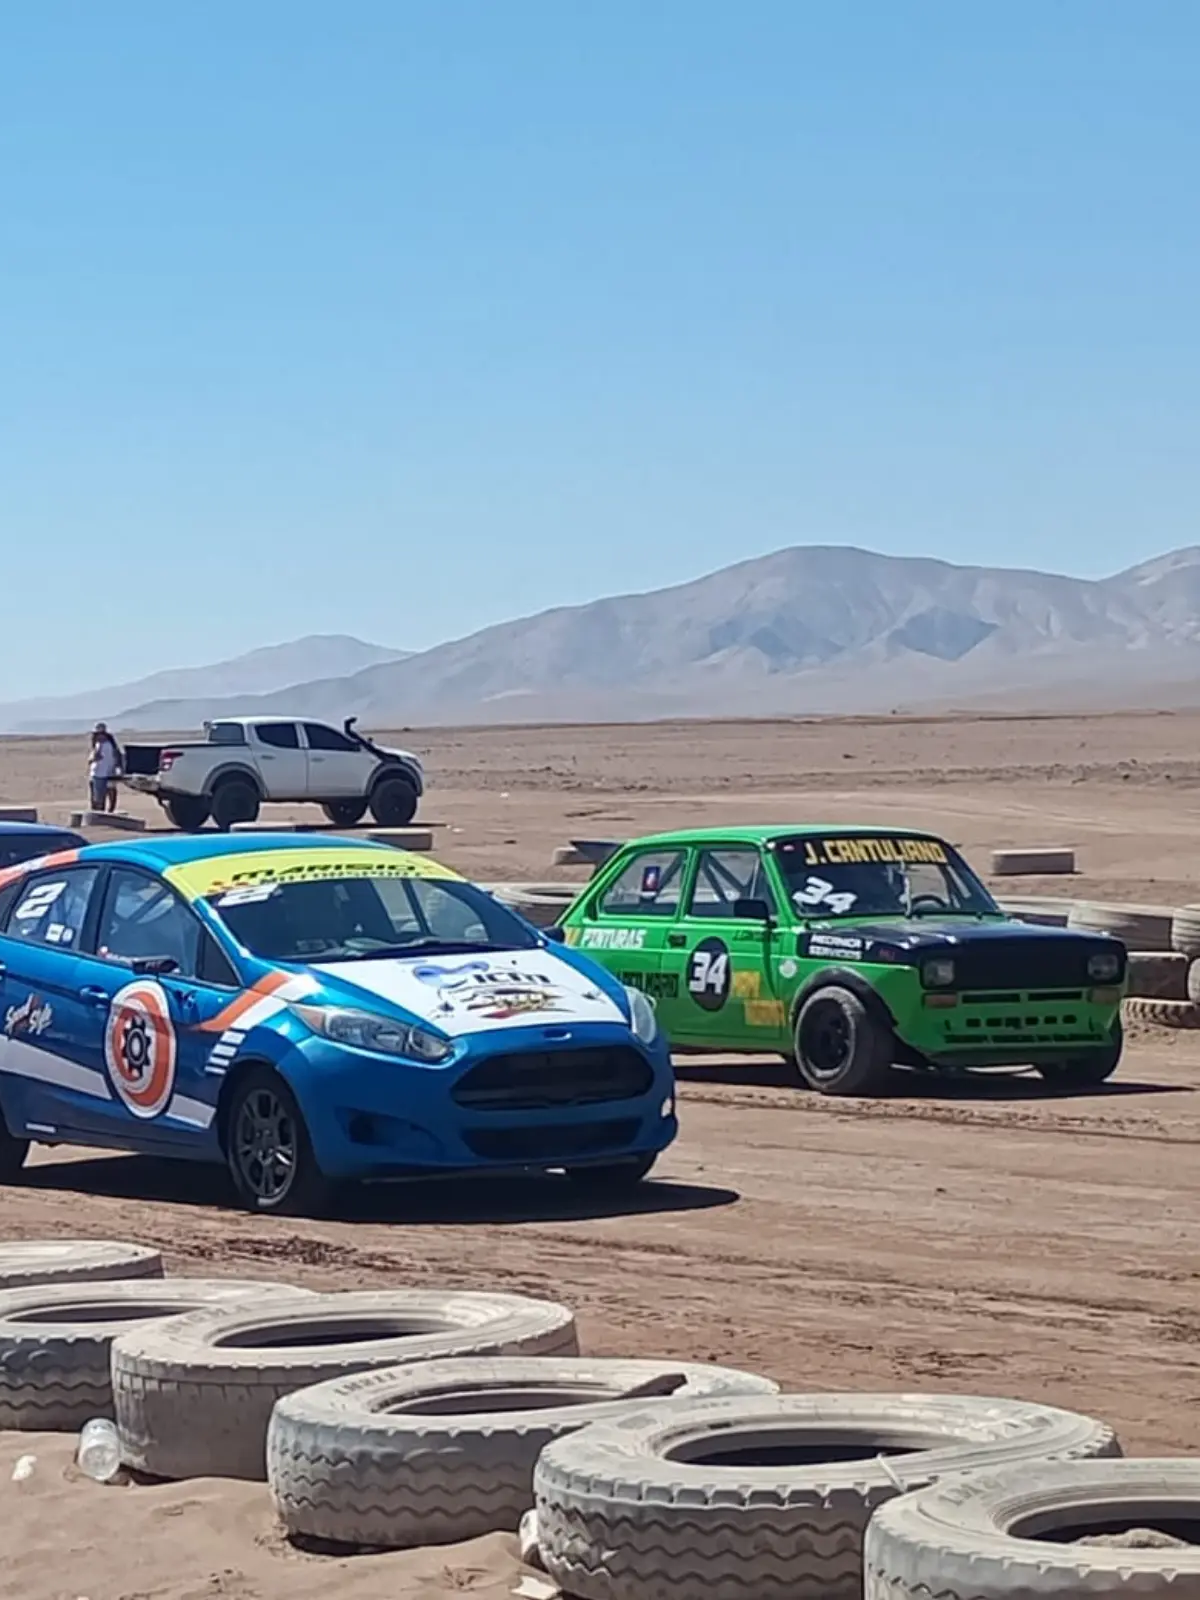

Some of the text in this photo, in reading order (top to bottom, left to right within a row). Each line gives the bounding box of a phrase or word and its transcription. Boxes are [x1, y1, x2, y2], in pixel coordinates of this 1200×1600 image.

[16, 881, 68, 920] 2
[792, 876, 858, 914] 34
[581, 927, 647, 949] PINTURAS
[689, 952, 728, 995] 34
